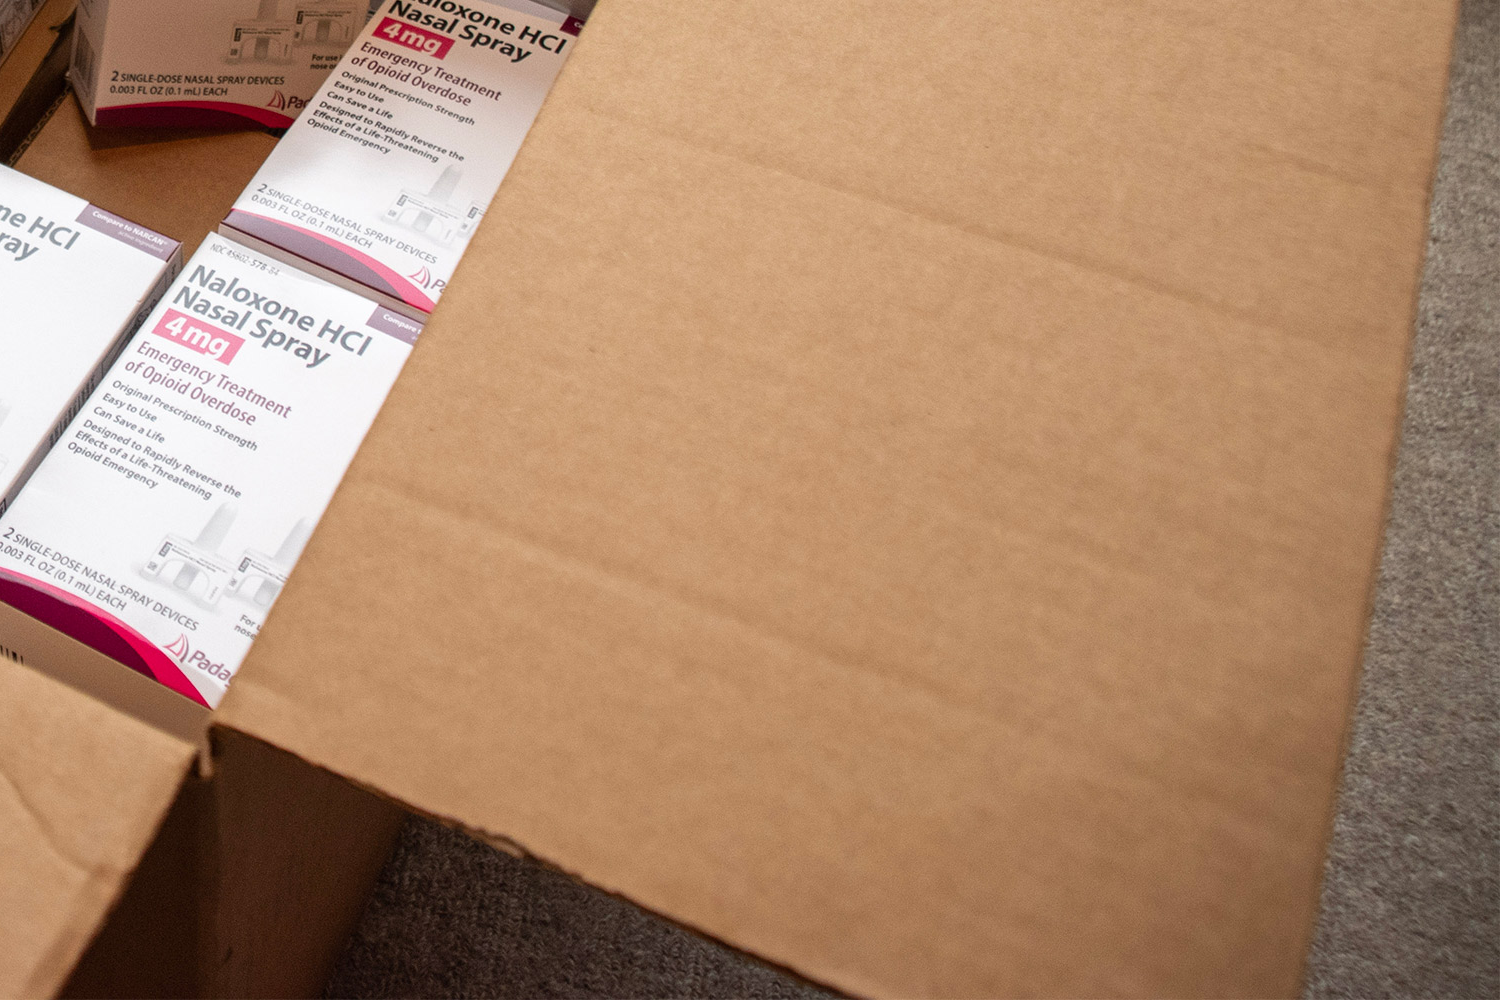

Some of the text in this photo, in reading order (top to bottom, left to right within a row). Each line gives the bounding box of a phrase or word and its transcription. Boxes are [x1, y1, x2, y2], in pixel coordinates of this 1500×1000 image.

[388, 0, 531, 63] Nasal Spray
[519, 26, 567, 54] HCl
[111, 71, 285, 85] 2 SINGLE-DOSE NASAL SPRAY DEVICES
[341, 70, 475, 125] Original Prescription Strength
[351, 56, 471, 106] of Opioid Overdose
[360, 41, 501, 101] Emergency Treatment
[28, 217, 80, 249] HCl
[92, 210, 124, 228] Compare
[123, 224, 133, 232] to
[173, 285, 330, 368] Nasal Spray
[189, 264, 373, 357] Naloxone HCl
[383, 314, 417, 333] Compare
[124, 361, 256, 425] of Opioid Overdose
[136, 340, 291, 418] Emergency Treatment
[112, 379, 257, 451] Original Prescription Strength
